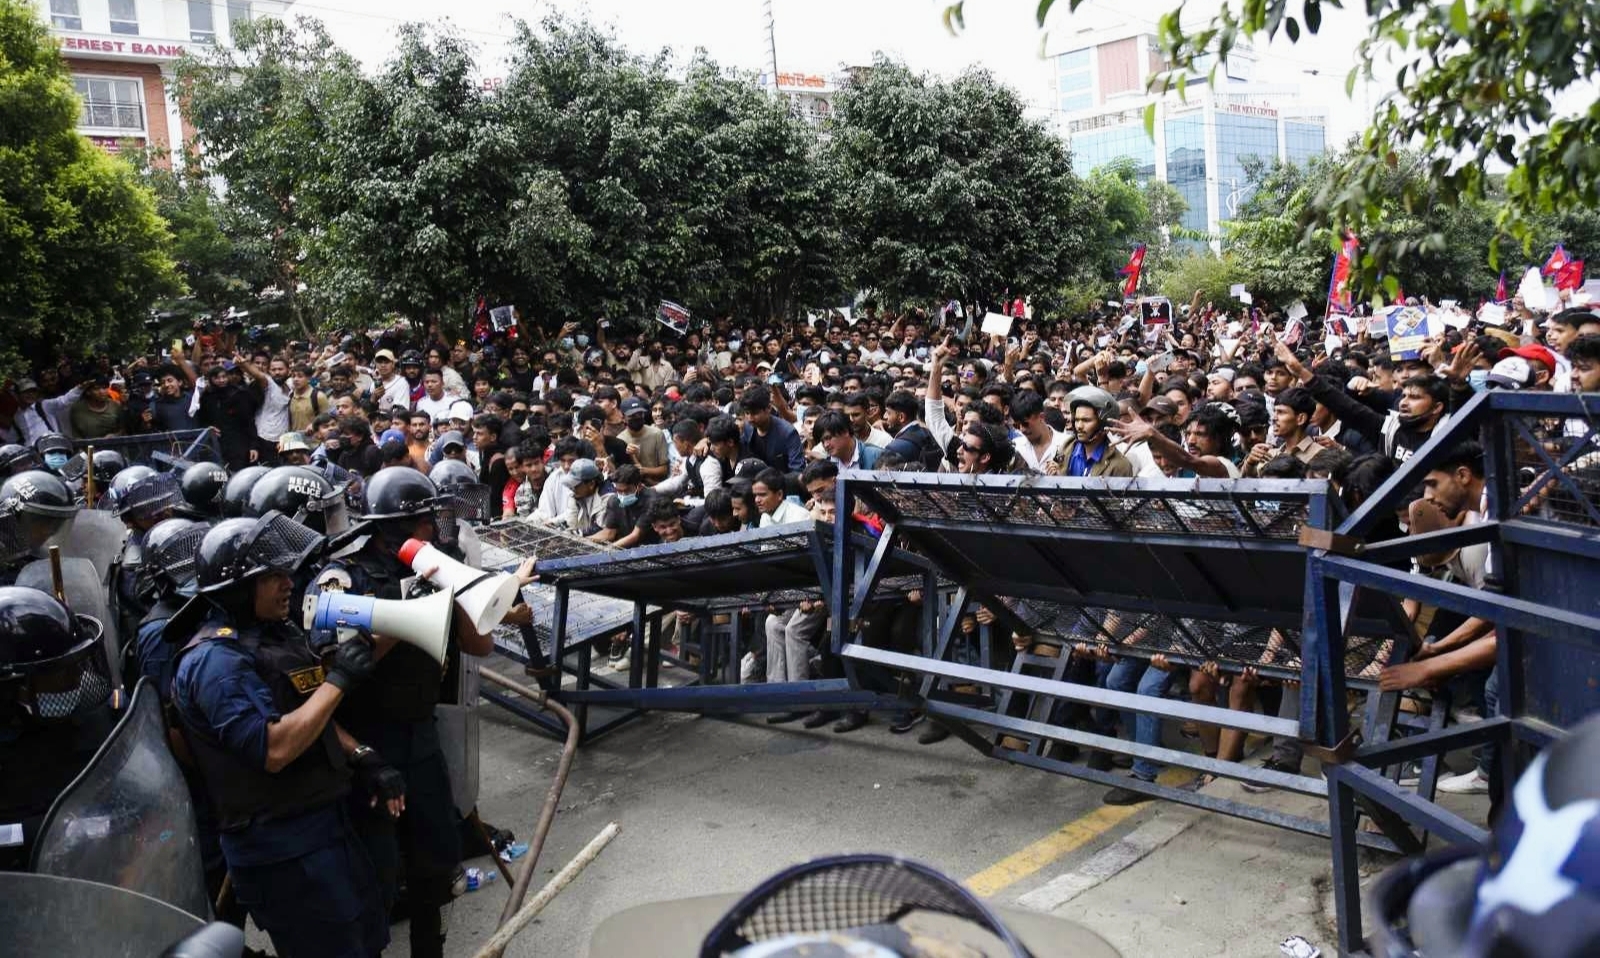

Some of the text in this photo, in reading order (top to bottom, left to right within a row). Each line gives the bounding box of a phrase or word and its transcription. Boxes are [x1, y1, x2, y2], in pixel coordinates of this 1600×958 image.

[61, 37, 185, 56] EREST BANK
[1242, 105, 1257, 114] NEXT
[288, 476, 321, 489] NEPAL
[288, 484, 321, 498] POLICE
